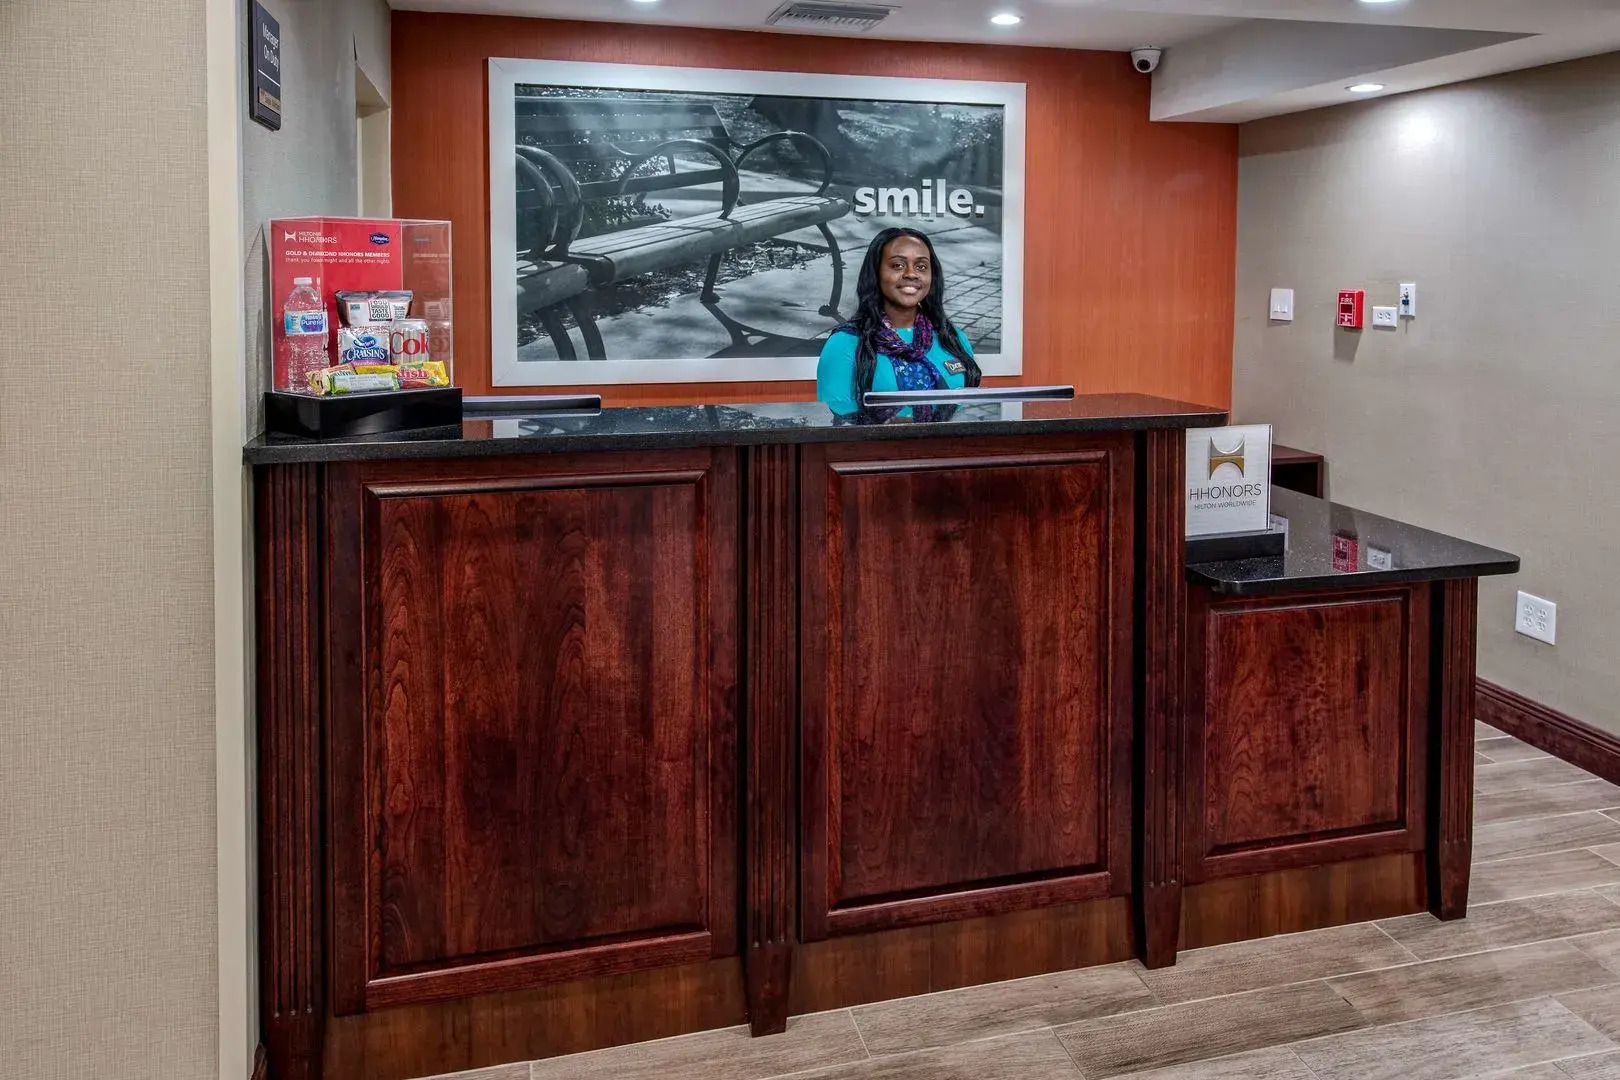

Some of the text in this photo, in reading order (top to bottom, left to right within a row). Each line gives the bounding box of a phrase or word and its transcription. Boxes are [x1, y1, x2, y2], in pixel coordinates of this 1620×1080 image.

[854, 178, 985, 216] smile.
[391, 332, 428, 355] Cok
[346, 348, 385, 361] CRAISINS
[1189, 483, 1262, 501] HHONORS
[1217, 499, 1257, 509] WORLDWIDE
